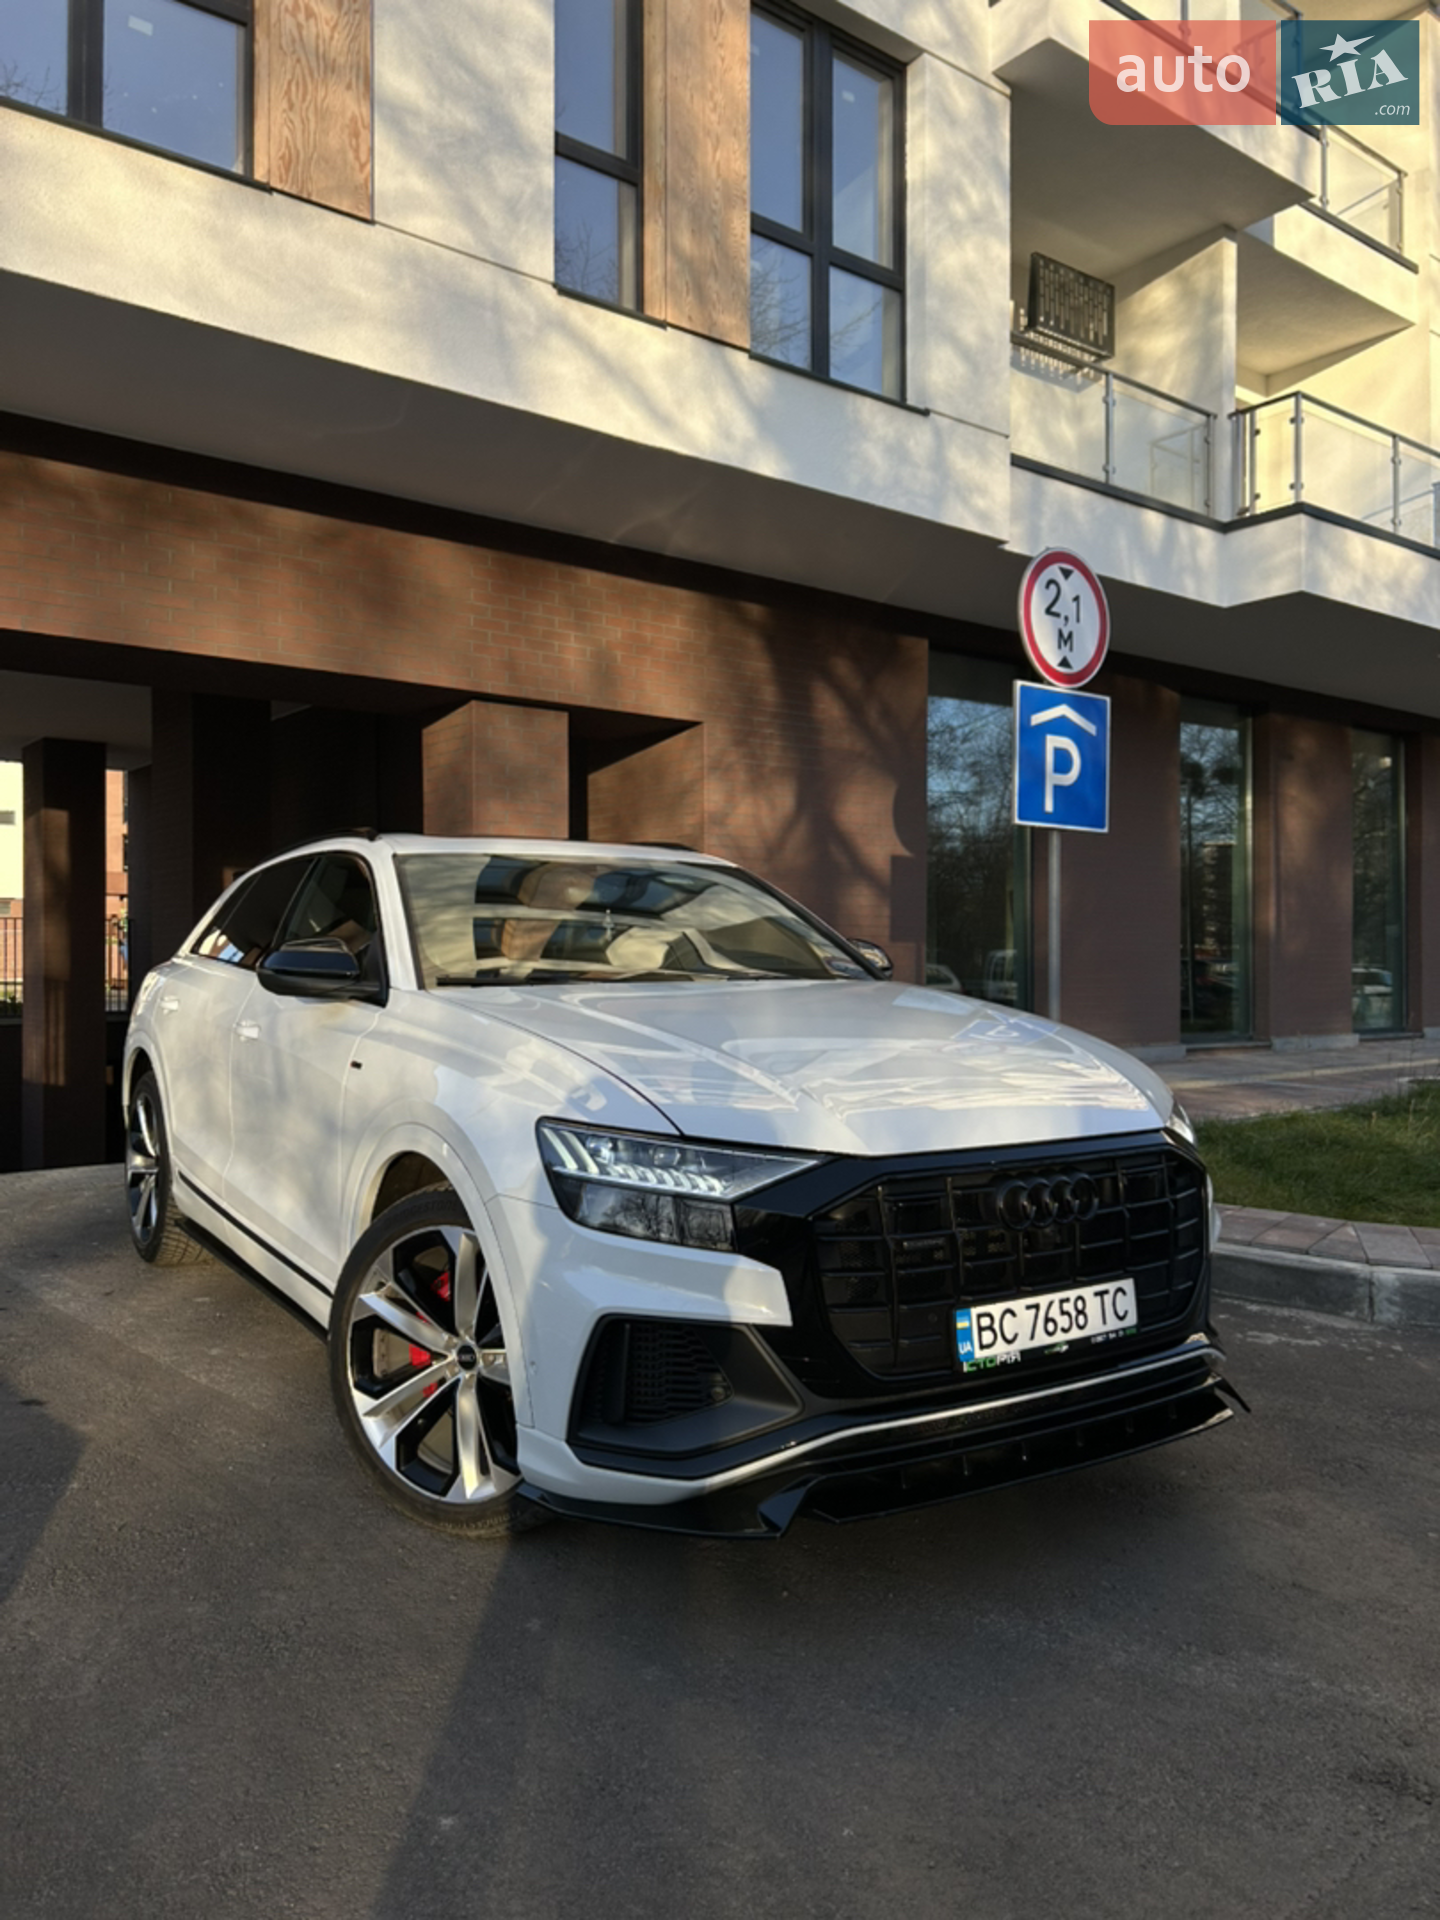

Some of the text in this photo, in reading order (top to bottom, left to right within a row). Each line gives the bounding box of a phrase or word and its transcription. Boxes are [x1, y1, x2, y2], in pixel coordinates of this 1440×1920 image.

[1044, 578, 1081, 626] 2,1
[1044, 733, 1082, 814] P
[976, 1307, 1019, 1351] BC
[1025, 1294, 1089, 1341] 7658
[1093, 1286, 1129, 1326] TC
[958, 1341, 973, 1355] UA
